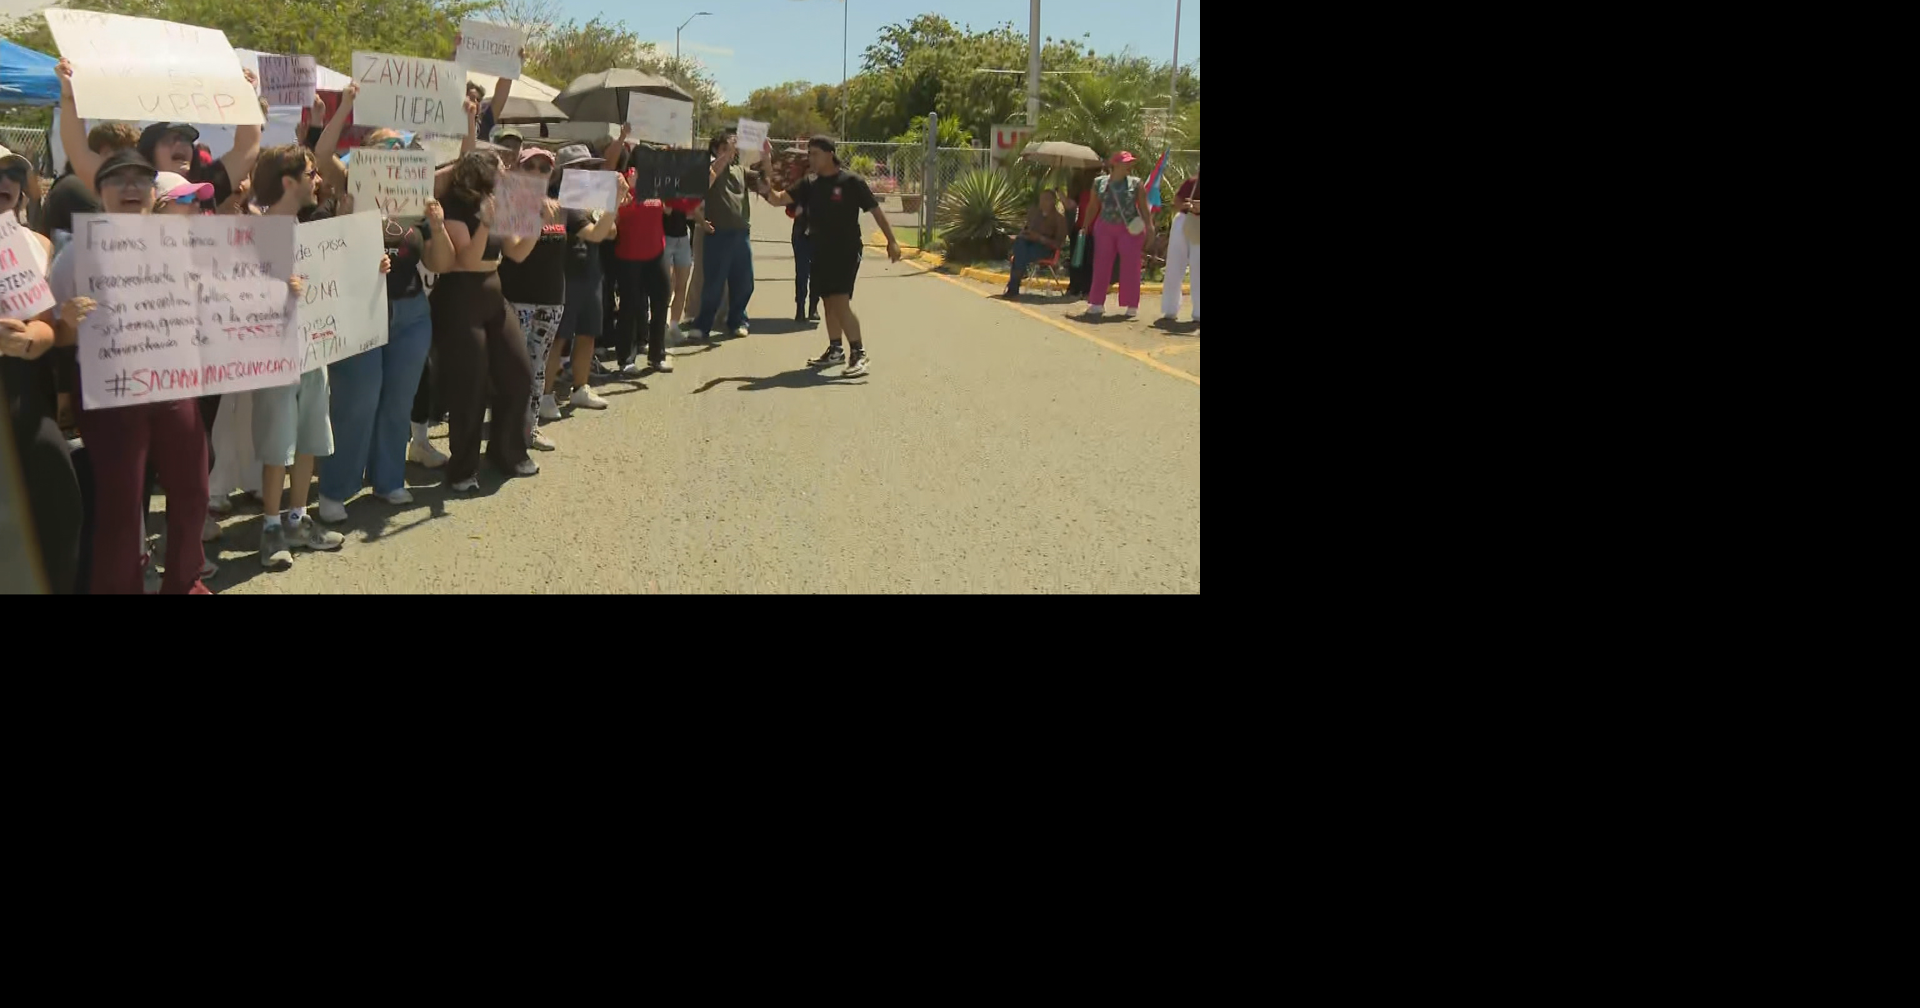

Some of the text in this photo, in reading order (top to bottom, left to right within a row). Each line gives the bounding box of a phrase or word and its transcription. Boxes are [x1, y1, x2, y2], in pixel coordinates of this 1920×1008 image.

[360, 56, 438, 91] ZAYIRA
[394, 94, 445, 124] FUERA
[386, 164, 427, 180] TESSIE
[542, 224, 565, 233] ONCE
[0, 269, 36, 295] STEMA
